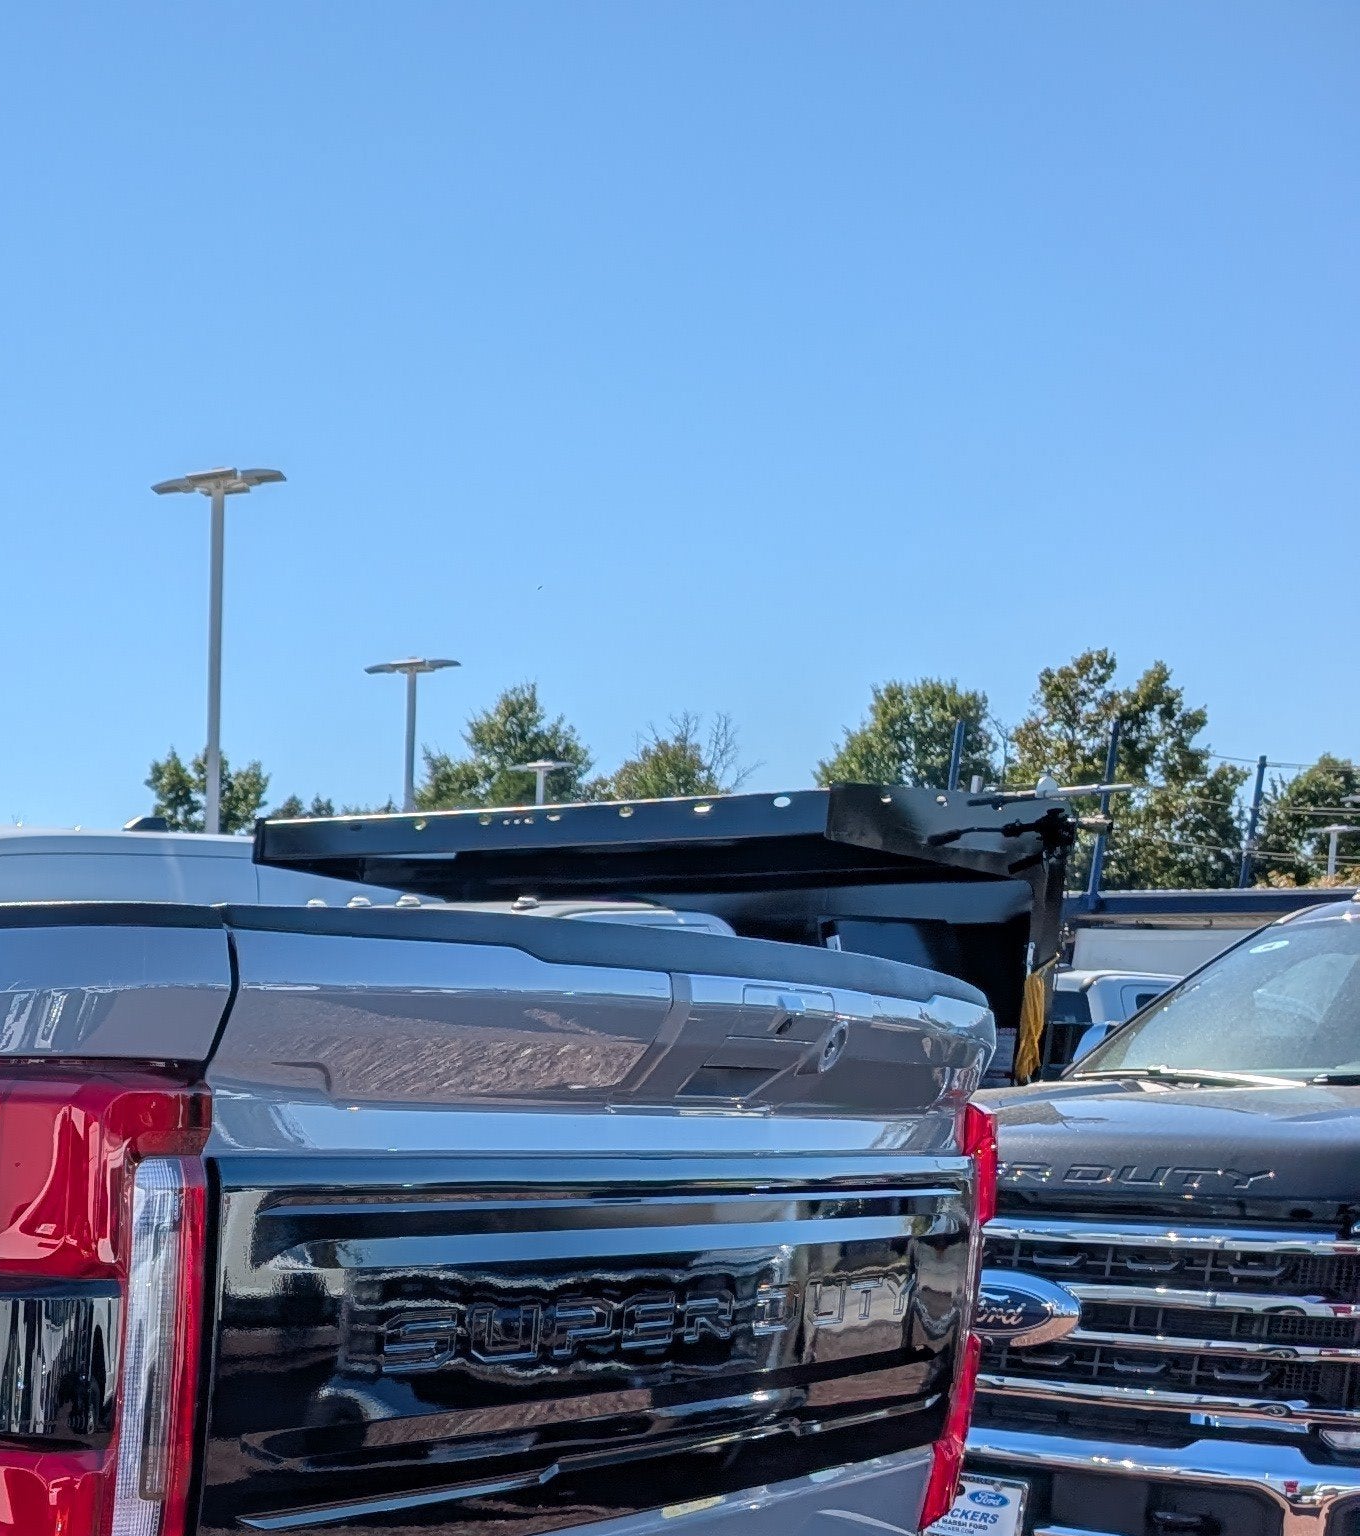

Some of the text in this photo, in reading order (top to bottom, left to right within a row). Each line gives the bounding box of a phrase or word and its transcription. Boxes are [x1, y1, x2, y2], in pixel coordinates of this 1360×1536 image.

[1063, 1162, 1276, 1189] DUTY
[381, 1273, 916, 1373] SUPER DUTY
[975, 1492, 1002, 1506] Ford
[949, 1508, 1000, 1525] CKERS
